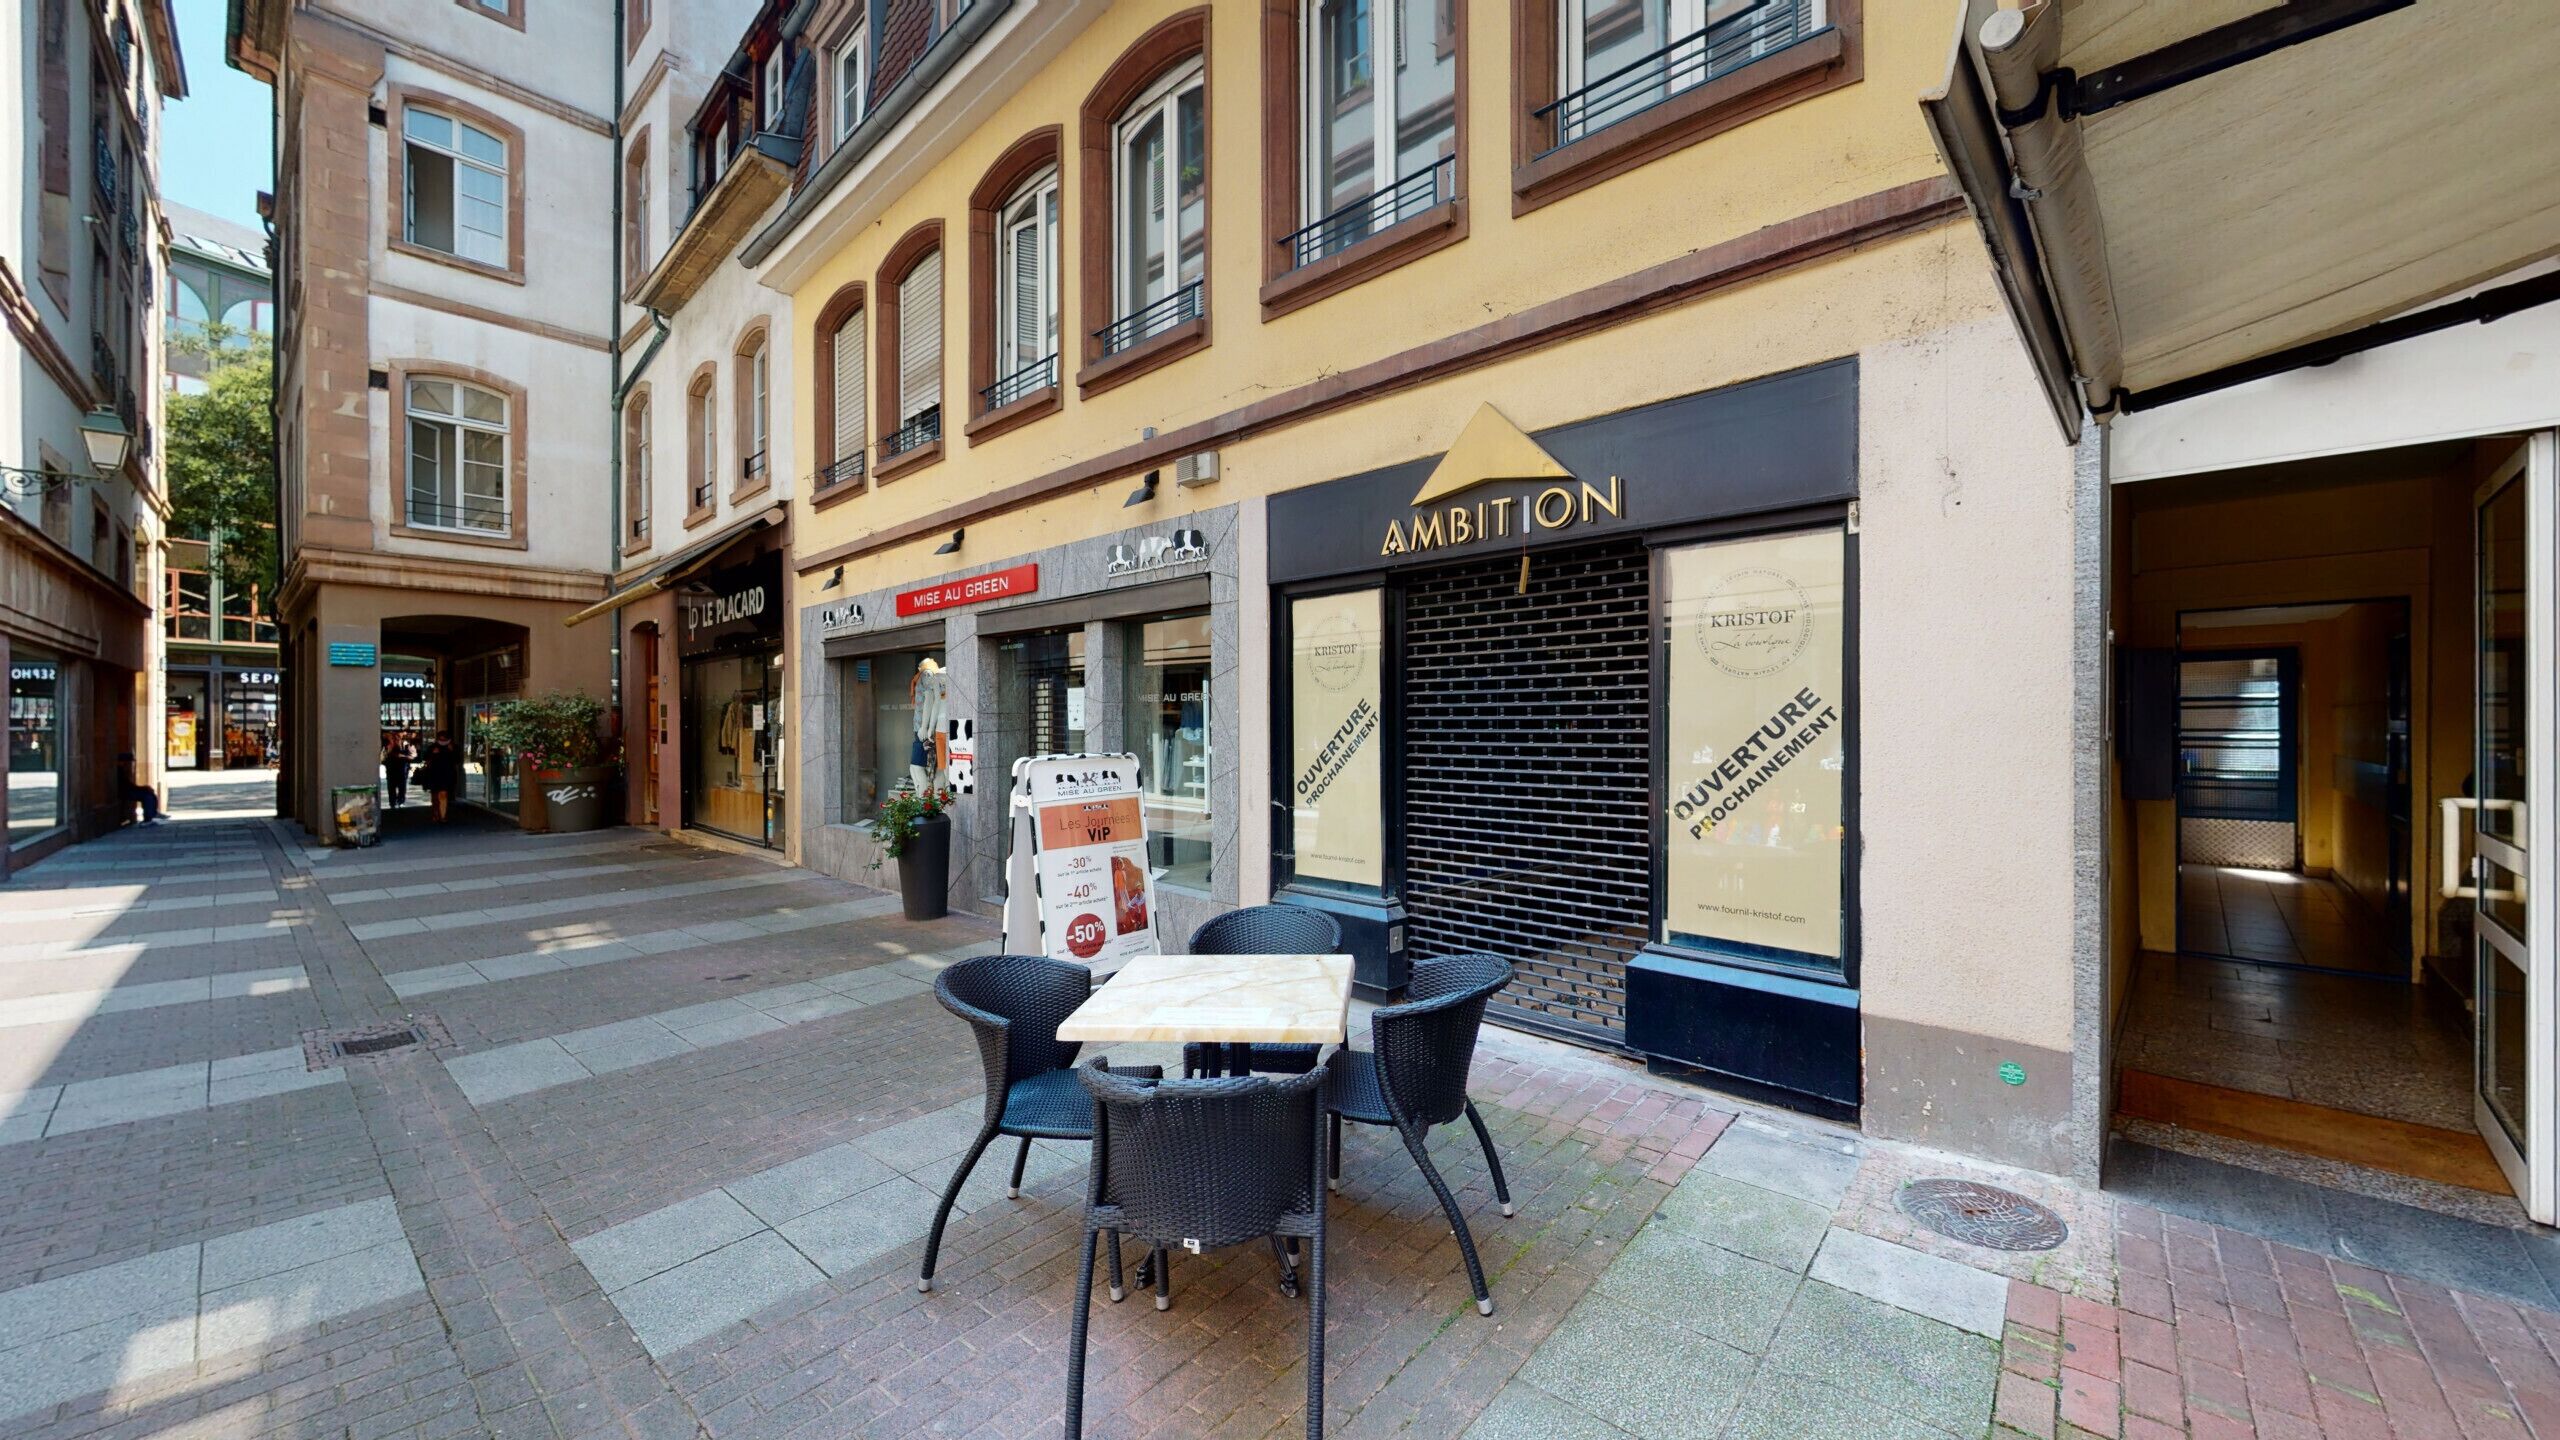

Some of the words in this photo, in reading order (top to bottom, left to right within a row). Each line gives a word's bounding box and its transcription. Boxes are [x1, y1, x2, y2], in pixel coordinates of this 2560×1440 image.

[1380, 475, 1625, 557] AMBITION
[913, 590, 940, 608] MISE
[944, 586, 960, 602] AU
[965, 576, 1009, 598] GREEN
[702, 601, 714, 627] LE
[716, 586, 765, 624] PLACARD
[1711, 609, 1796, 628] KRISTOF
[1314, 643, 1358, 656] KRISTOF
[1163, 693, 1177, 702] AU
[1296, 698, 1371, 795] OUVERTURE
[1673, 686, 1822, 821] OUVERTURE
[1306, 711, 1379, 809] PROCHAINEMENT
[1689, 705, 1839, 840] PROCHAINEMENT
[1057, 790, 1080, 798] MISE
[1097, 785, 1122, 793] GREEN
[1059, 818, 1081, 831] Les
[1067, 882, 1098, 899] -40%
[1697, 903, 1806, 925] www.fournil-kristof.com
[1067, 920, 1105, 943] -50%
